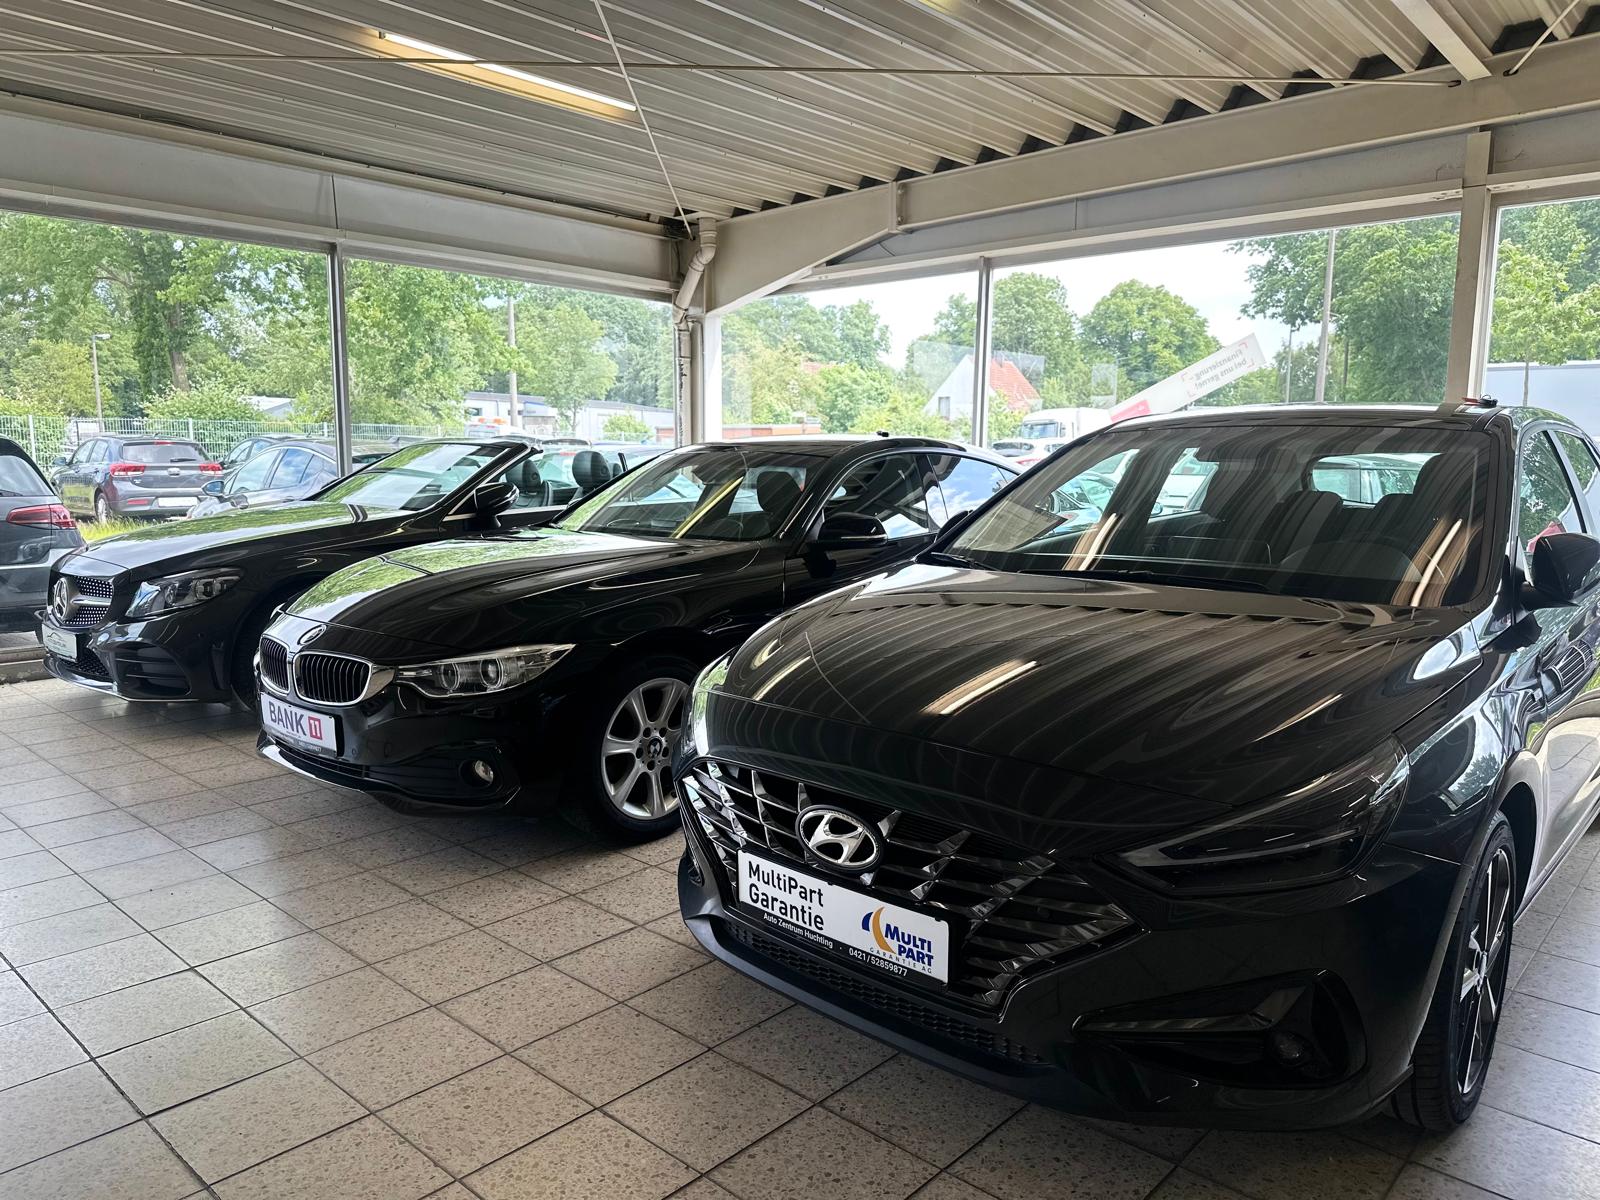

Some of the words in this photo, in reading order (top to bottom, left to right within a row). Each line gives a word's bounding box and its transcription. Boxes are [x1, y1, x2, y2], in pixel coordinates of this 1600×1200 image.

[268, 701, 307, 736] BANK
[309, 719, 321, 738] 11
[748, 860, 824, 908] MultiPart
[749, 883, 825, 931] Garantie
[763, 912, 778, 925] Auto
[778, 919, 804, 936] Zentrum
[804, 930, 834, 949] Huchting
[848, 948, 908, 977] 0421/52859877
[884, 923, 932, 954] MULTI
[897, 944, 934, 967] PART
[869, 947, 917, 968] GARANTIE
[921, 965, 932, 974] AG
